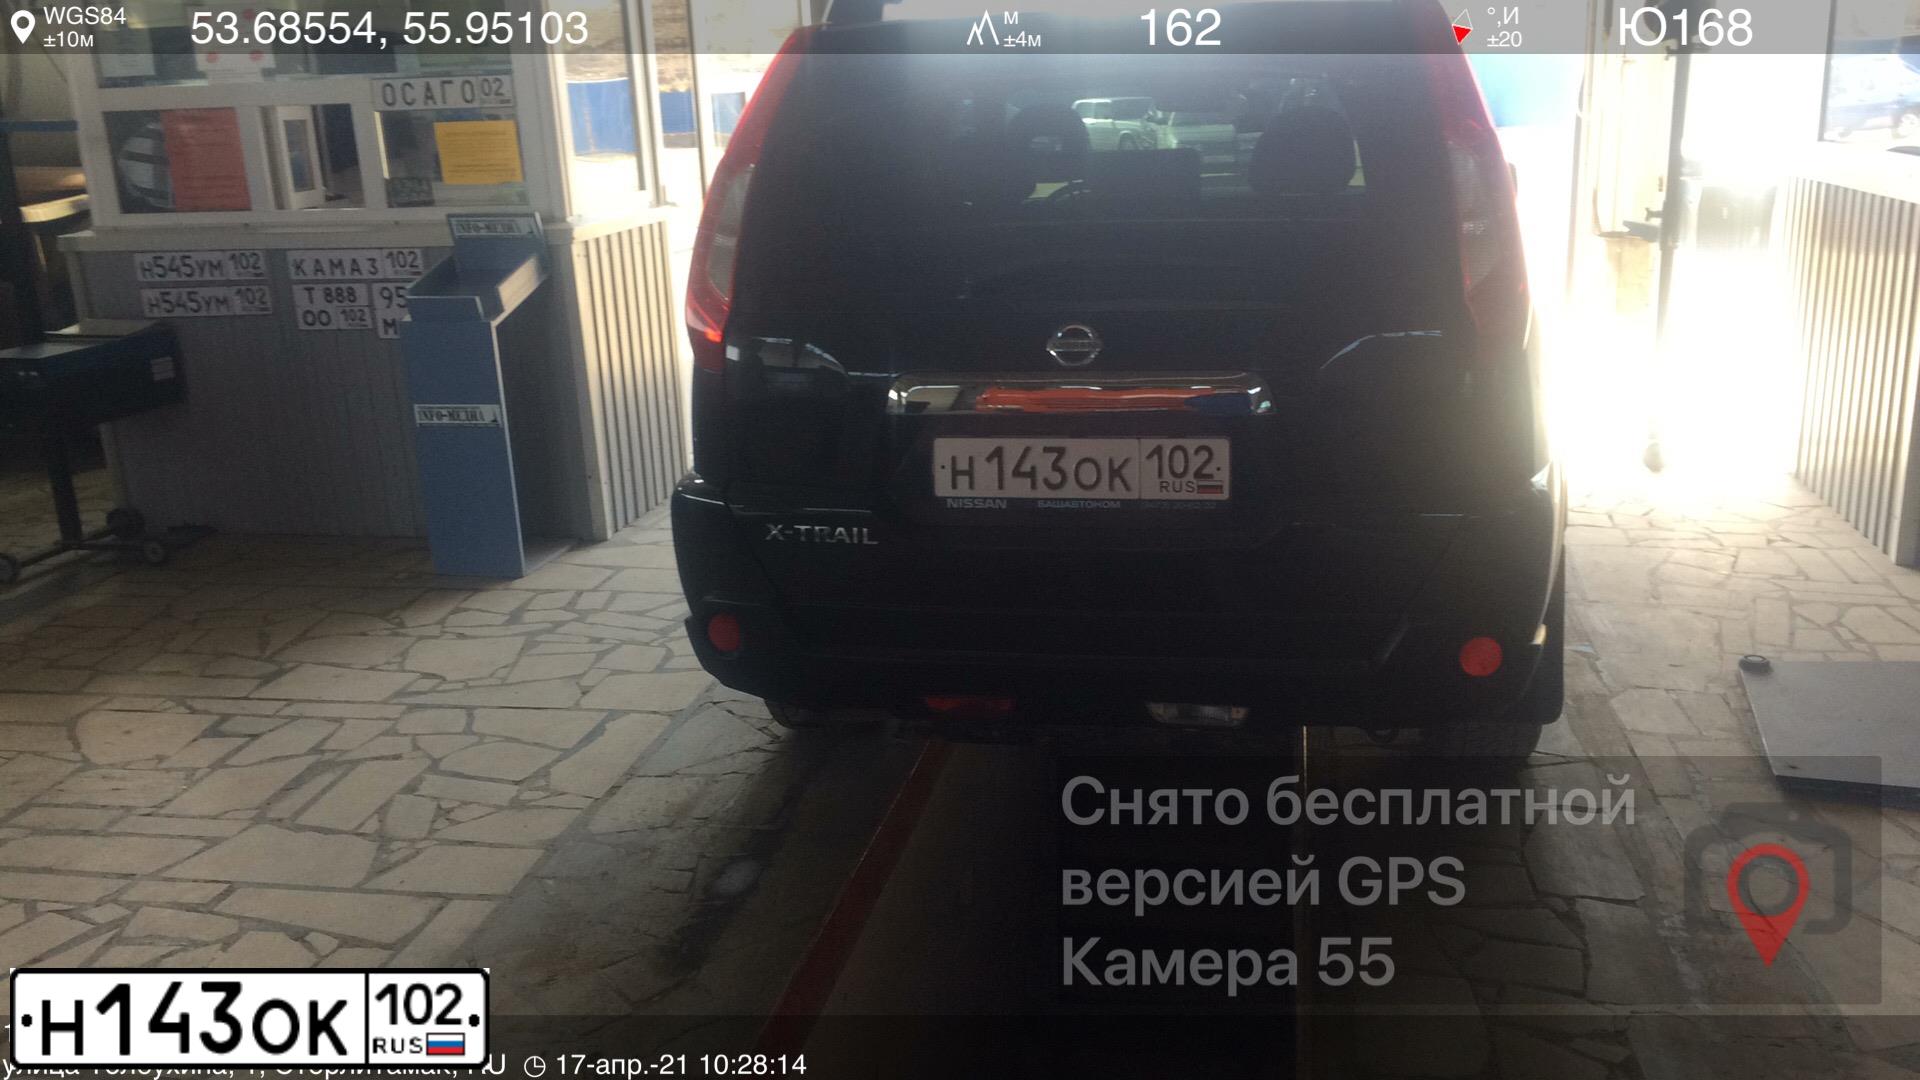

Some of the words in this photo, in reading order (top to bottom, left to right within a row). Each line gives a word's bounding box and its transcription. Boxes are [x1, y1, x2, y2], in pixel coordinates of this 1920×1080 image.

[381, 79, 476, 107] ОСАГО
[480, 77, 505, 97] 02
[228, 251, 262, 270] 102
[385, 250, 420, 269] 102
[235, 287, 268, 305] 102
[323, 286, 357, 304] 888
[949, 444, 1134, 493] Н143ОК
[1145, 443, 1215, 480] 102
[1158, 480, 1196, 494] RUS
[945, 498, 1007, 510] NISSAN
[765, 523, 880, 545] X-TRAIL
